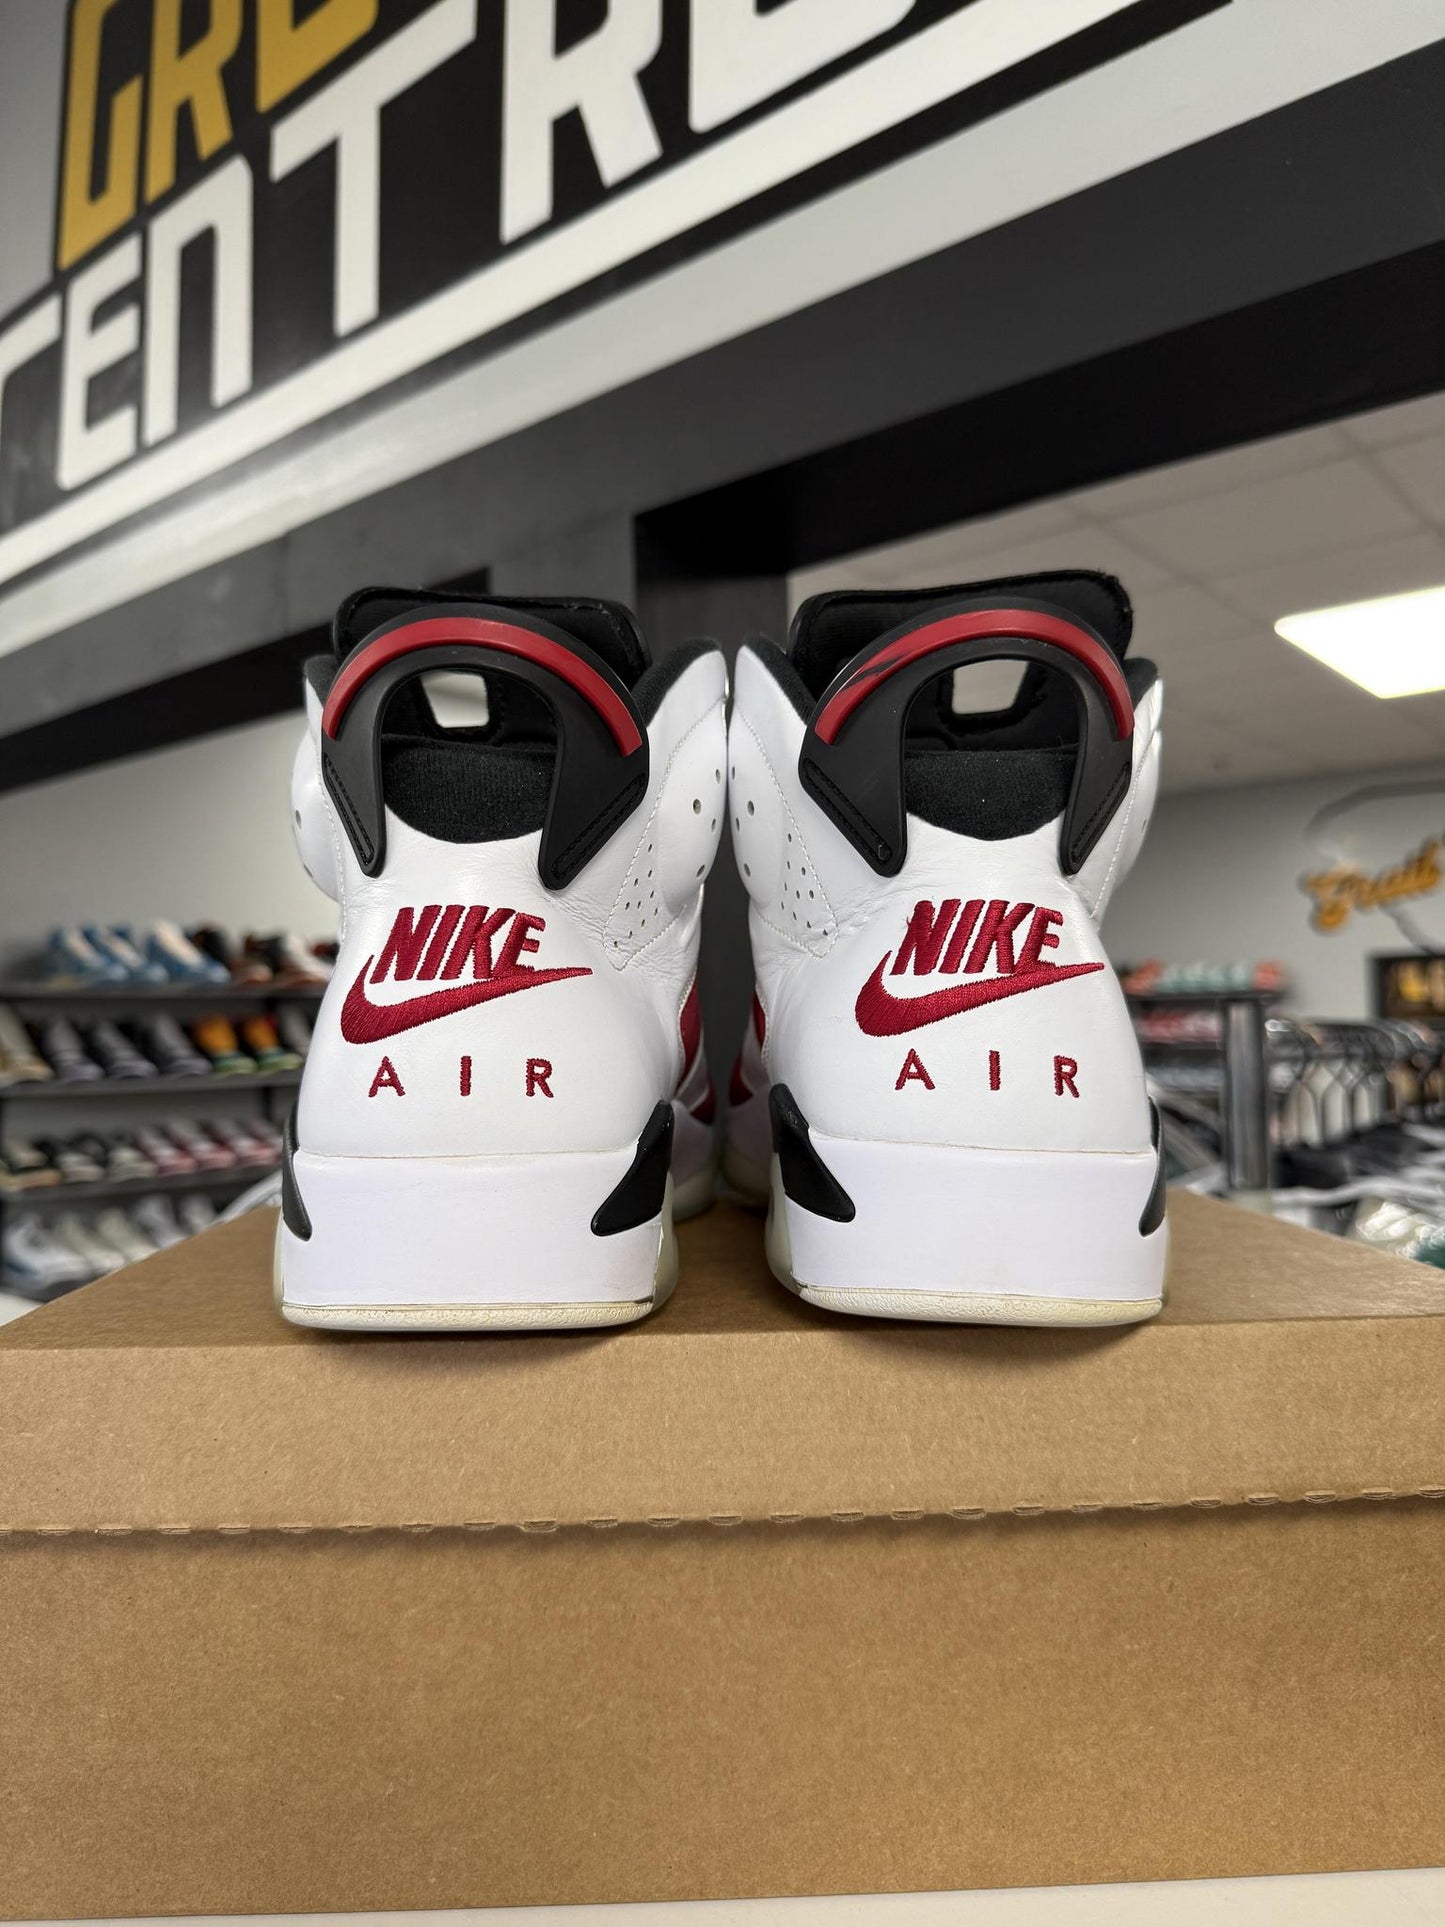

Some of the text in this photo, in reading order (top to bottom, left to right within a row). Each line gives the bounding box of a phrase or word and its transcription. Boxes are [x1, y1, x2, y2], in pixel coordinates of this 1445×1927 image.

[369, 904, 546, 984] NIKE
[890, 898, 1063, 976] NIKE
[368, 1056, 554, 1098] AIR
[895, 1048, 1080, 1098] AIR
